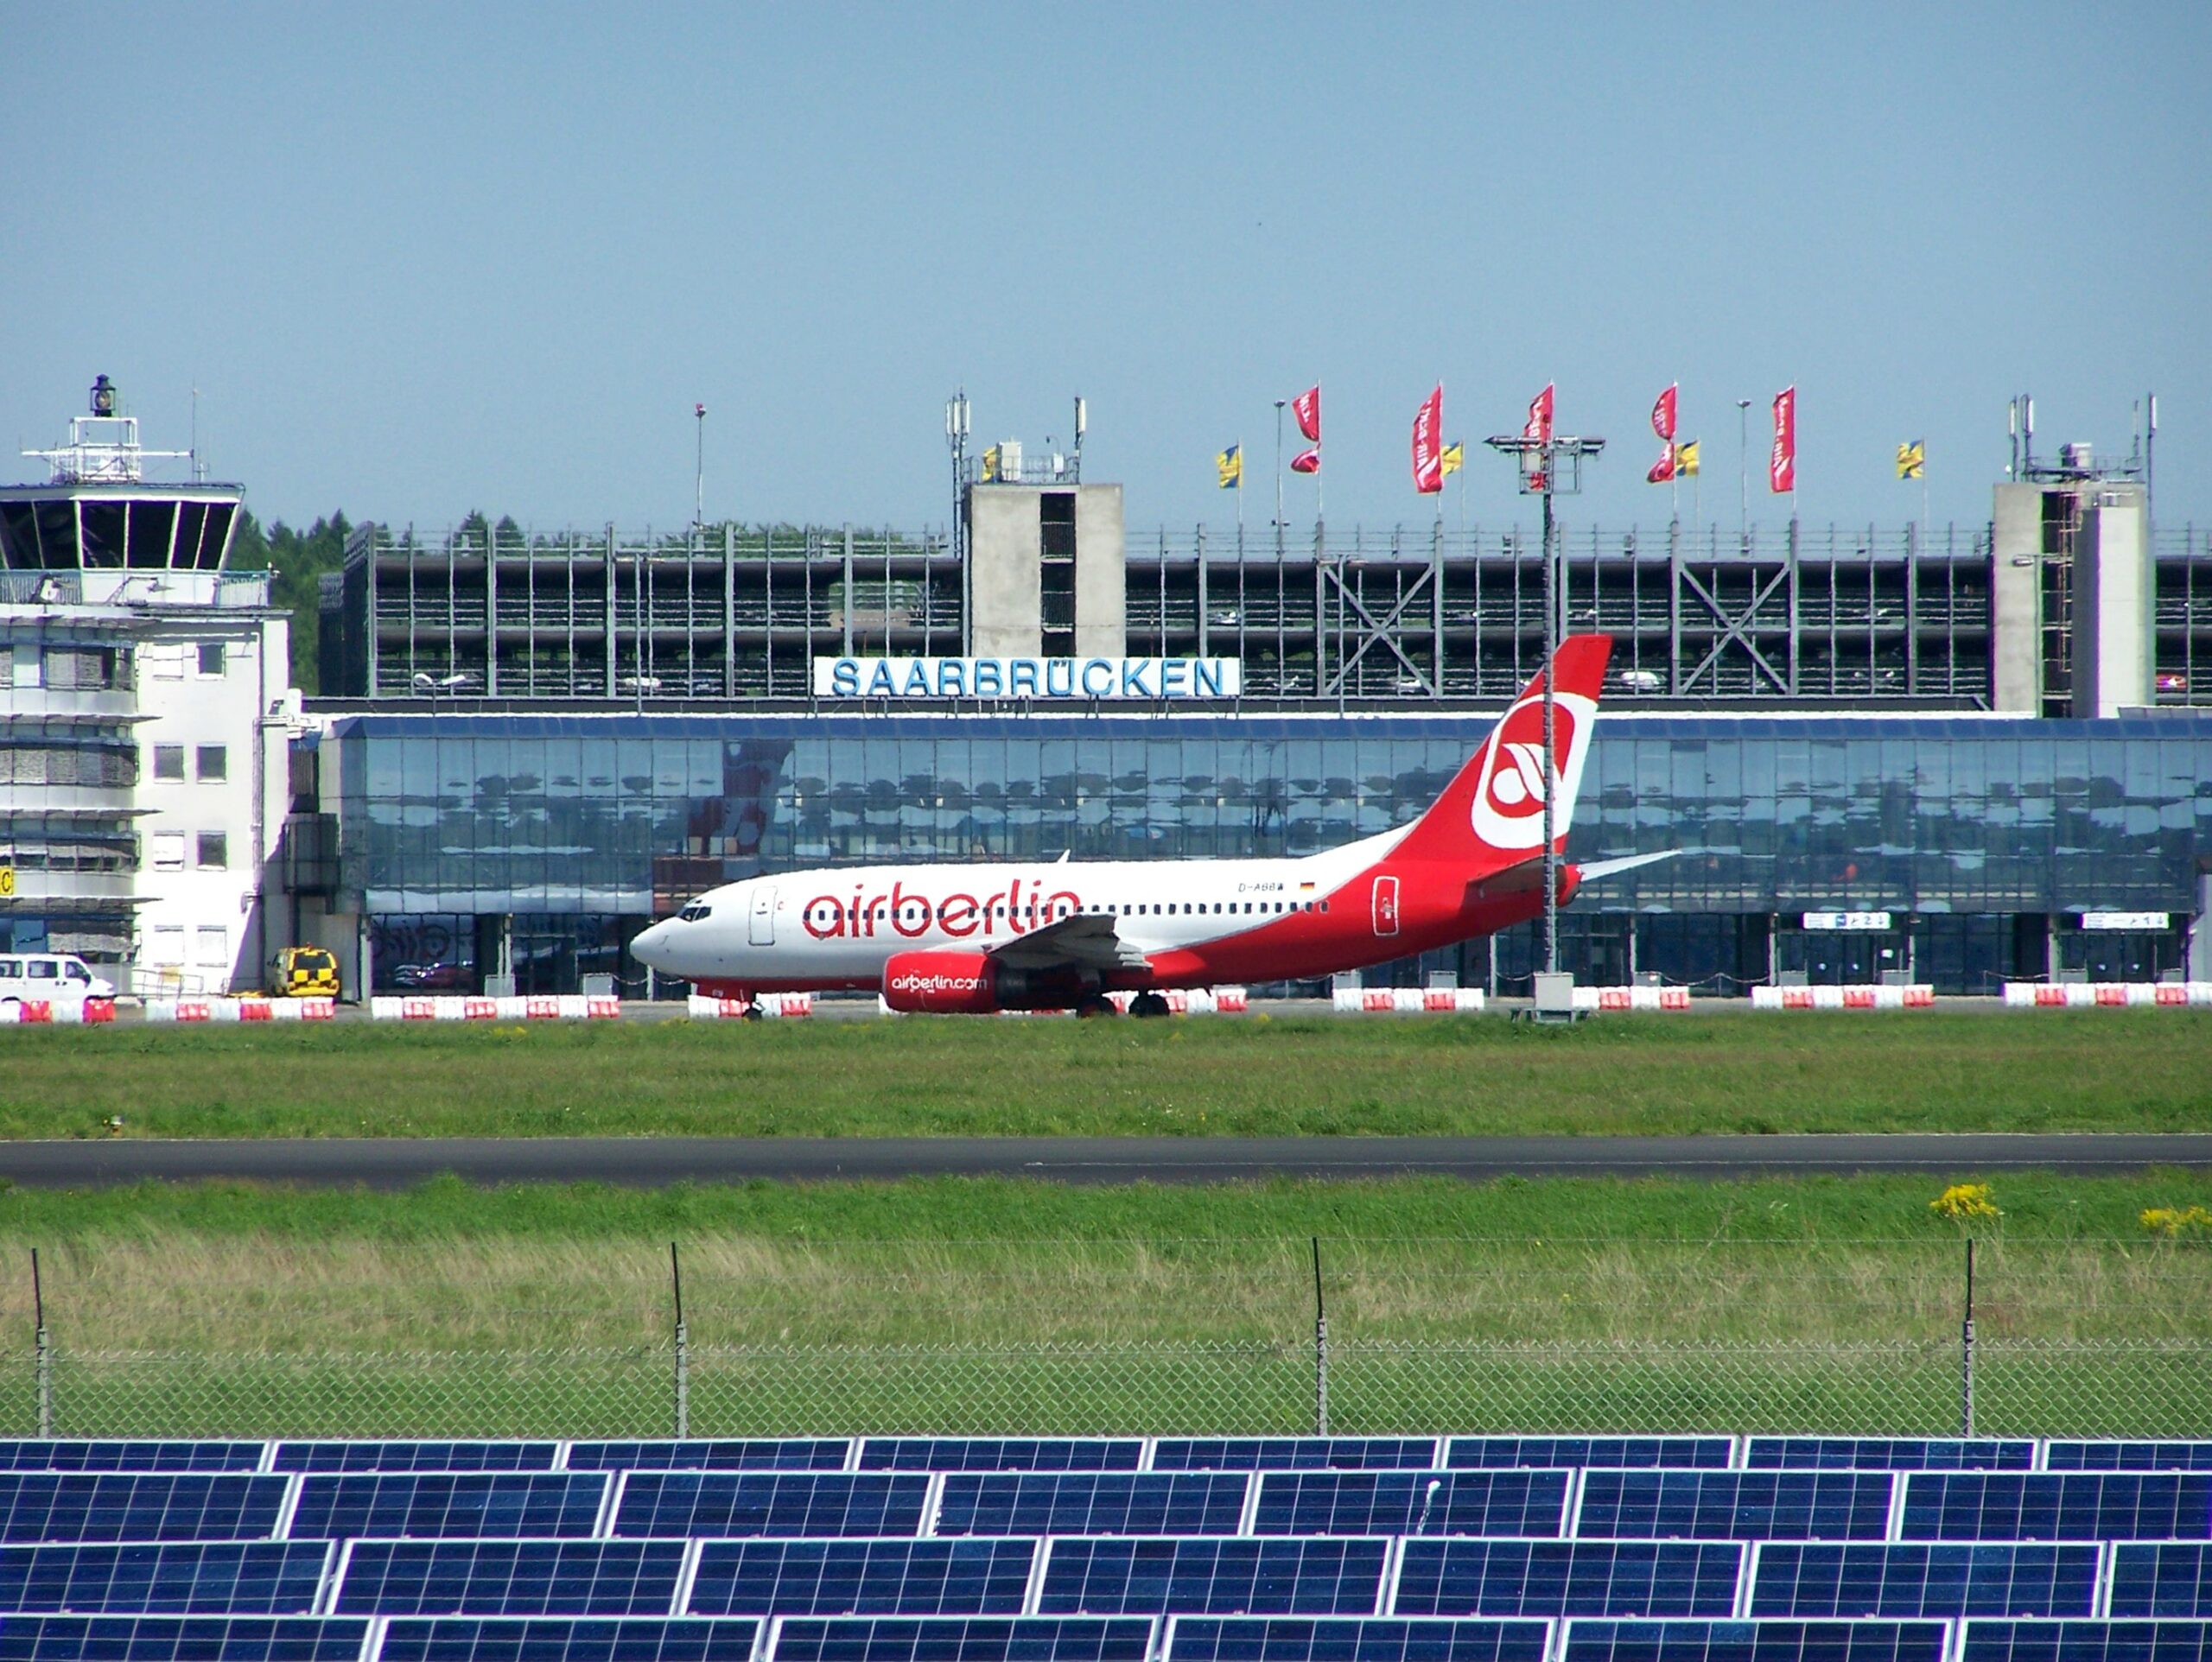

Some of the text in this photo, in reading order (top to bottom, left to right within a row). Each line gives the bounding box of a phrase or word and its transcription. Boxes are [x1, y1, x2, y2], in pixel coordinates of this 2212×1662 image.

[832, 658, 1224, 697] SAARBRÜCKEN
[802, 879, 1082, 940] airberlin
[891, 974, 987, 991] airberlin.com
